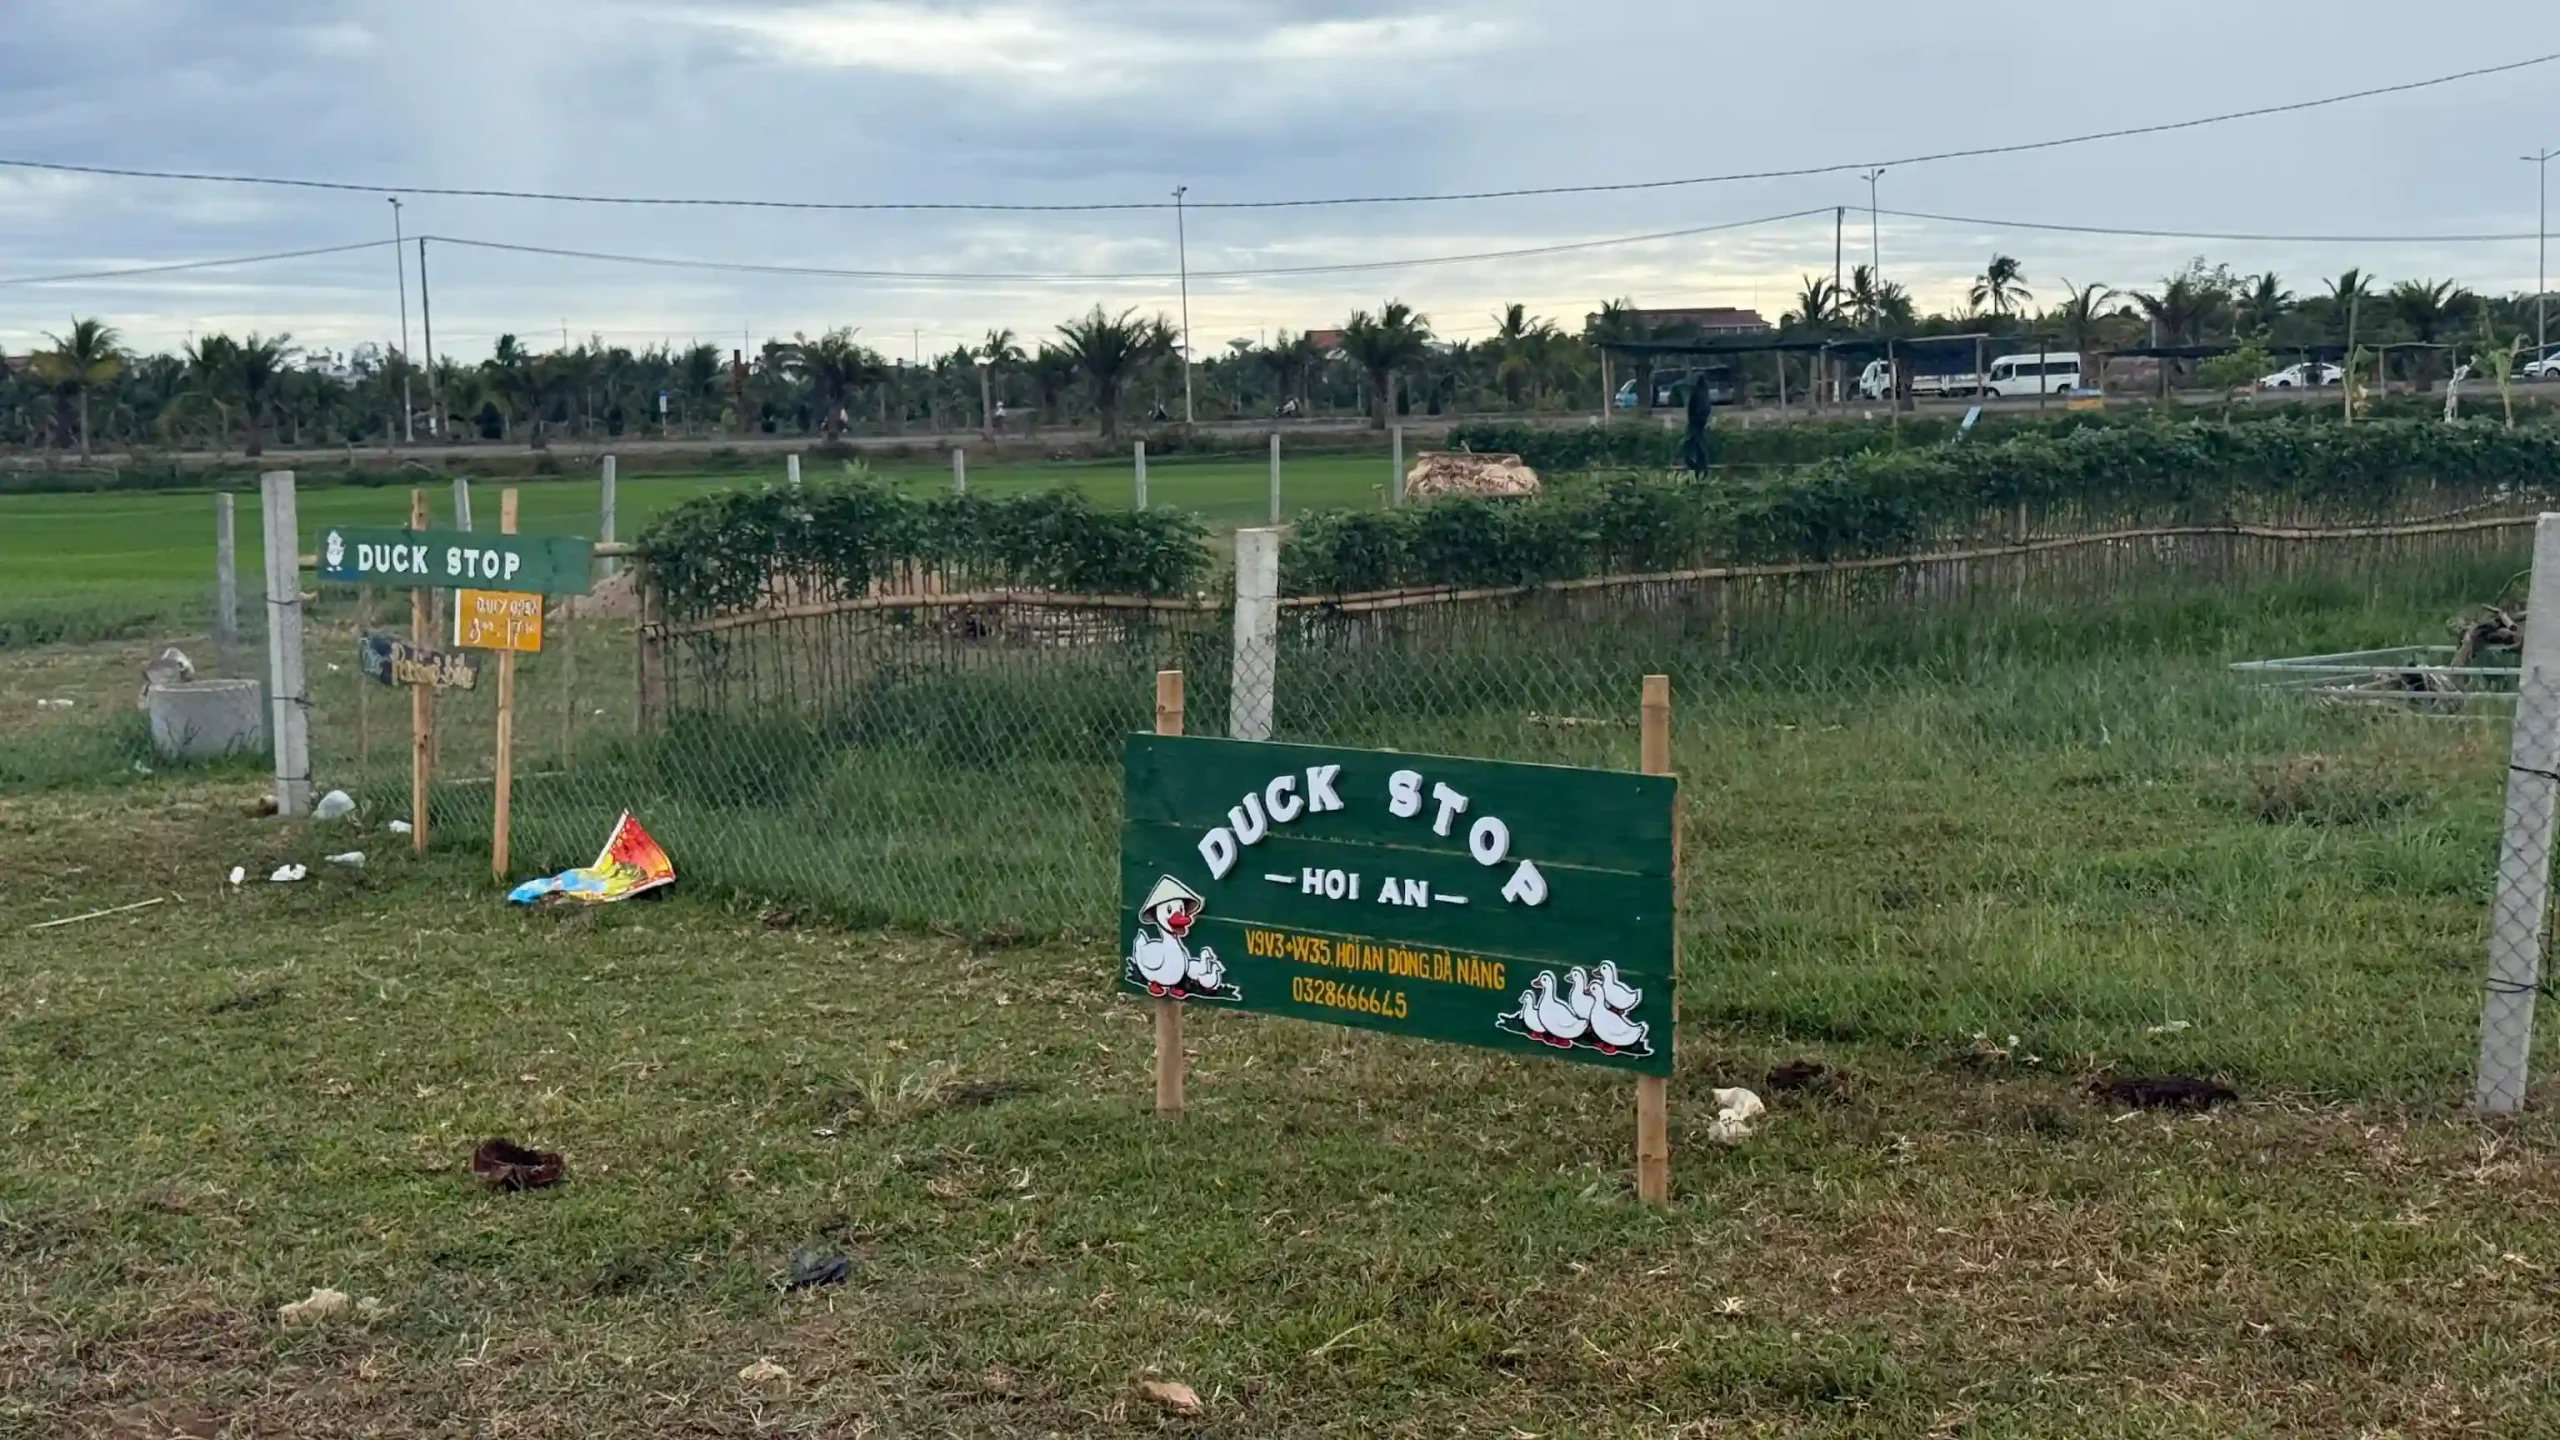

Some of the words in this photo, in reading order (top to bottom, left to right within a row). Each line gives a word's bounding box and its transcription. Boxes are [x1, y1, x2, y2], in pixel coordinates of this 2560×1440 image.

[357, 543, 429, 574] DUCK
[447, 546, 520, 581] STOP
[1198, 764, 1344, 880] DUCK
[1389, 770, 1548, 906] STOP
[1302, 867, 1361, 900] HOI
[1377, 877, 1429, 907] AN
[1361, 945, 1383, 973] AN
[1292, 976, 1408, 1019] 0328666645
